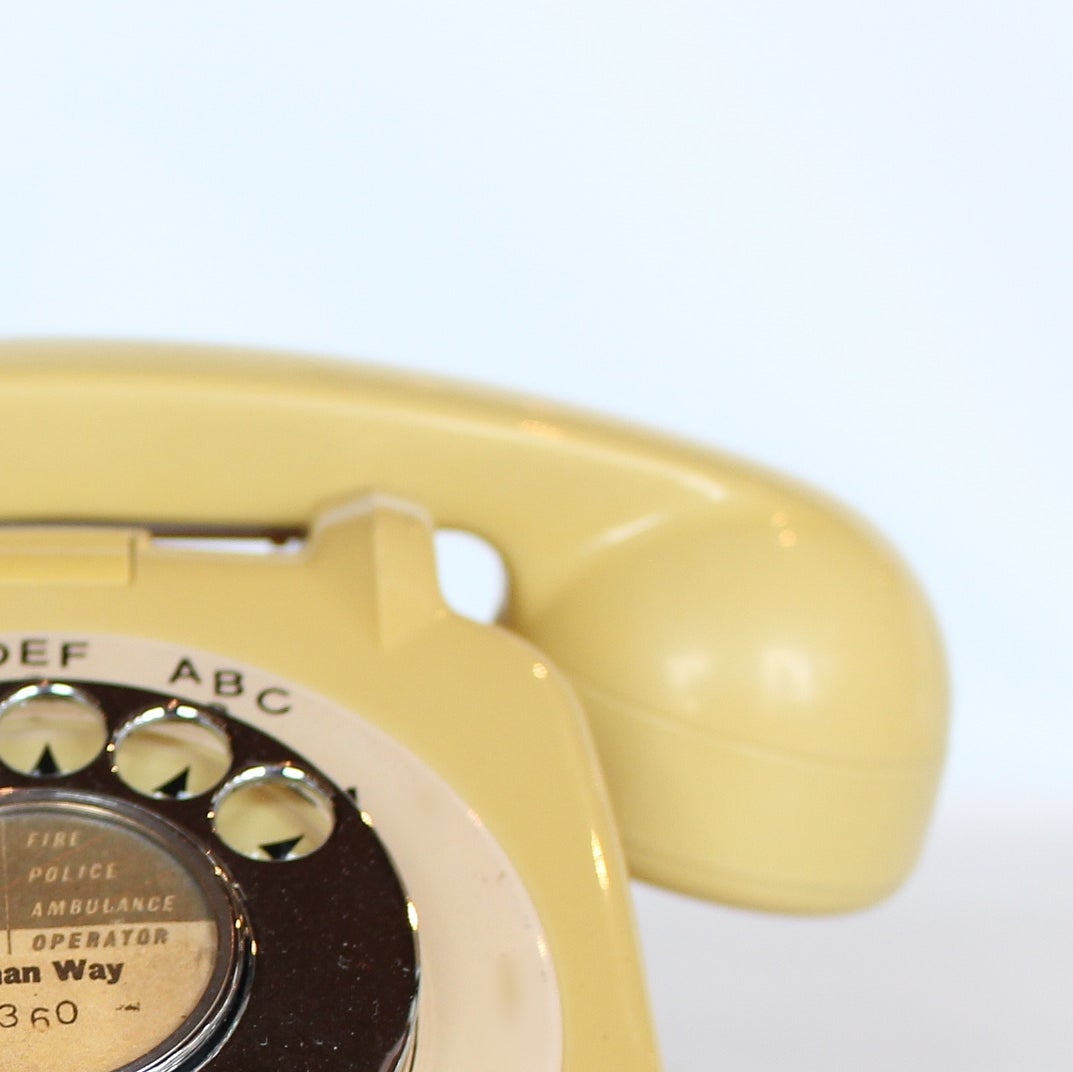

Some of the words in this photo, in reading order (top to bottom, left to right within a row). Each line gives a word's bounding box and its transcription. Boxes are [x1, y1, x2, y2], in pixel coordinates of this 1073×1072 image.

[27, 831, 81, 848] FIRE
[29, 863, 118, 883] POLICE
[32, 895, 175, 918] AMBULANCE
[32, 927, 169, 951] OPERATOR
[54, 959, 124, 984] Way
